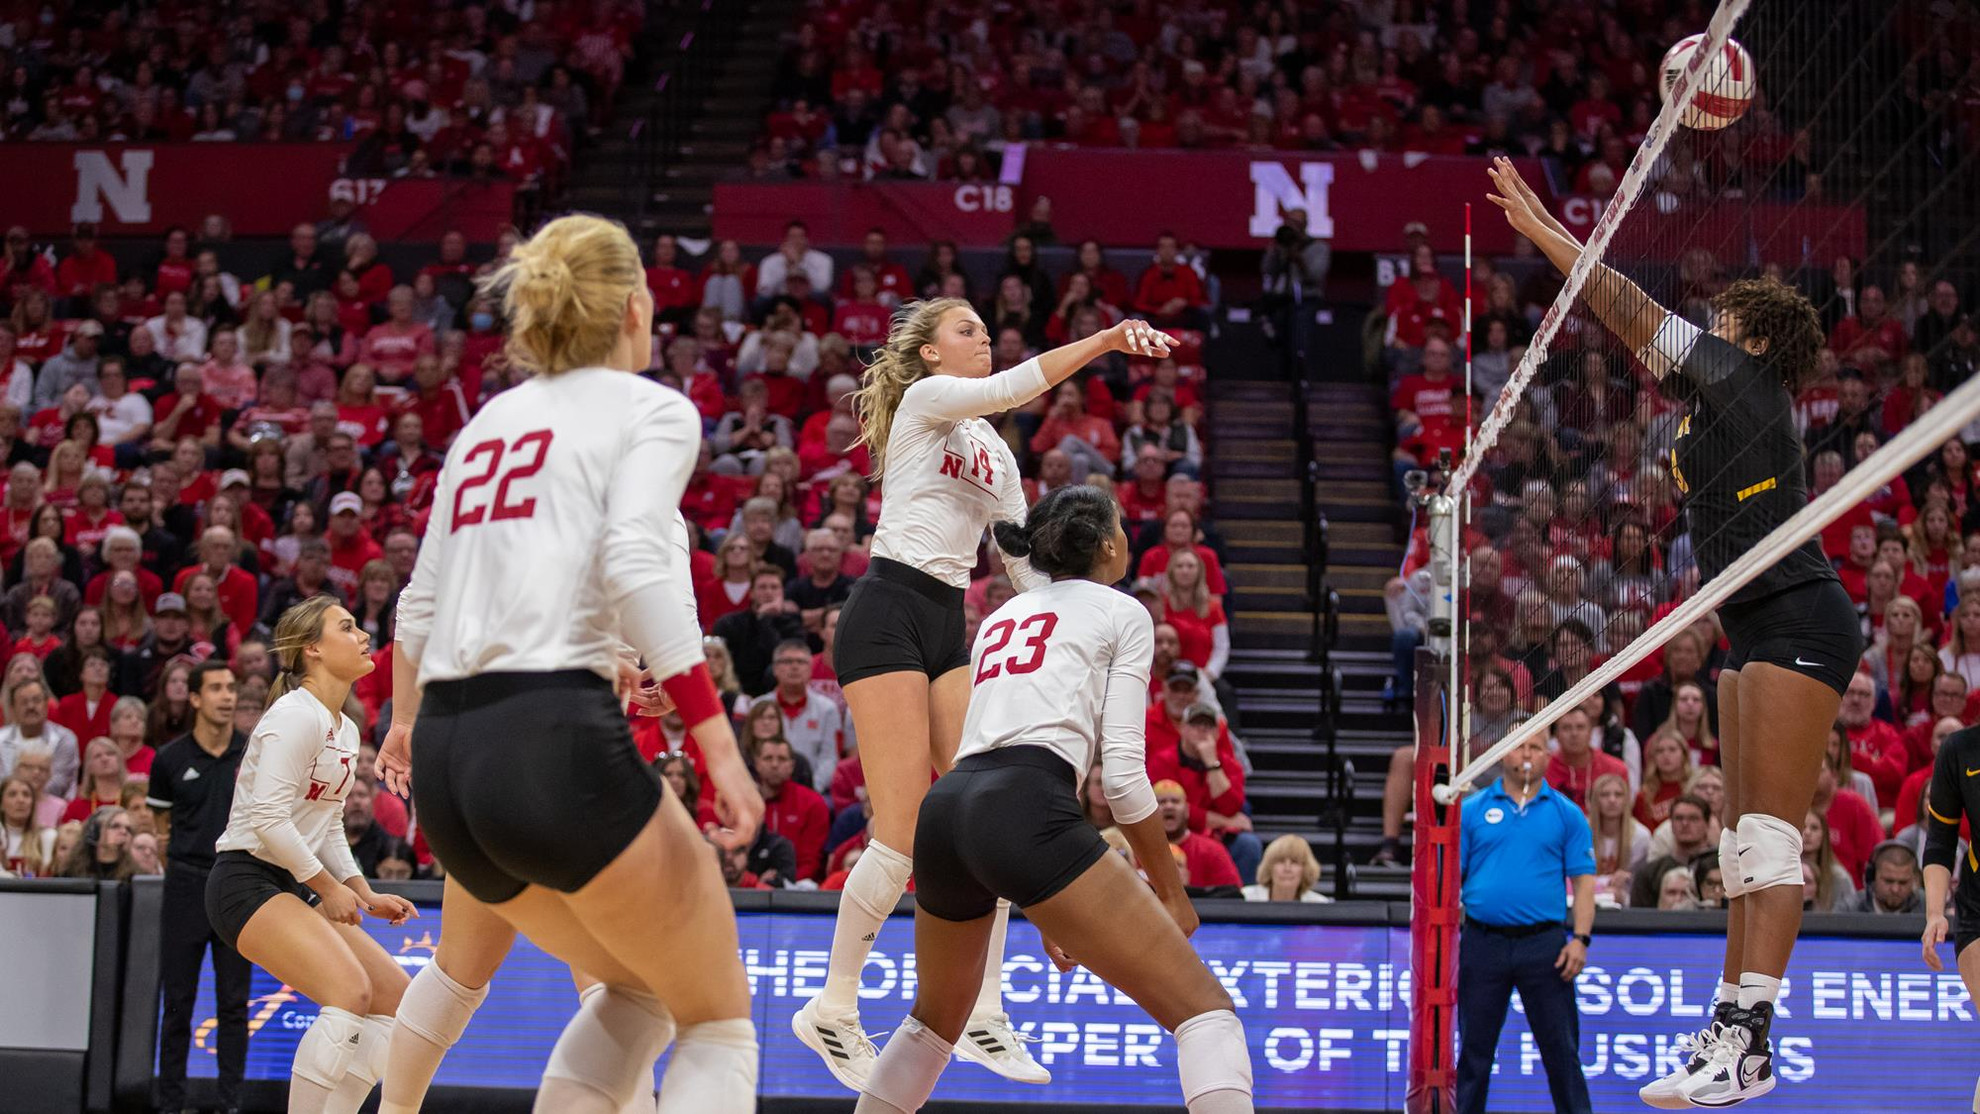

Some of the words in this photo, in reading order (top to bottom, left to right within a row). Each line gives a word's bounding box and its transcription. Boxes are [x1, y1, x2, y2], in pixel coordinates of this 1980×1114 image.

[72, 150, 155, 223] N
[954, 185, 1013, 212] C18
[1248, 161, 1334, 238] N
[1563, 196, 1611, 225] C1
[450, 428, 554, 535] 22
[939, 453, 963, 479] N
[969, 440, 994, 486] 14
[974, 611, 1059, 688] 23
[304, 781, 327, 802] N
[334, 757, 351, 795] 7
[738, 948, 830, 998] HE
[1203, 959, 1411, 1011] XTERI
[1574, 966, 1793, 1019] SOL
[1264, 1027, 1354, 1074] OF
